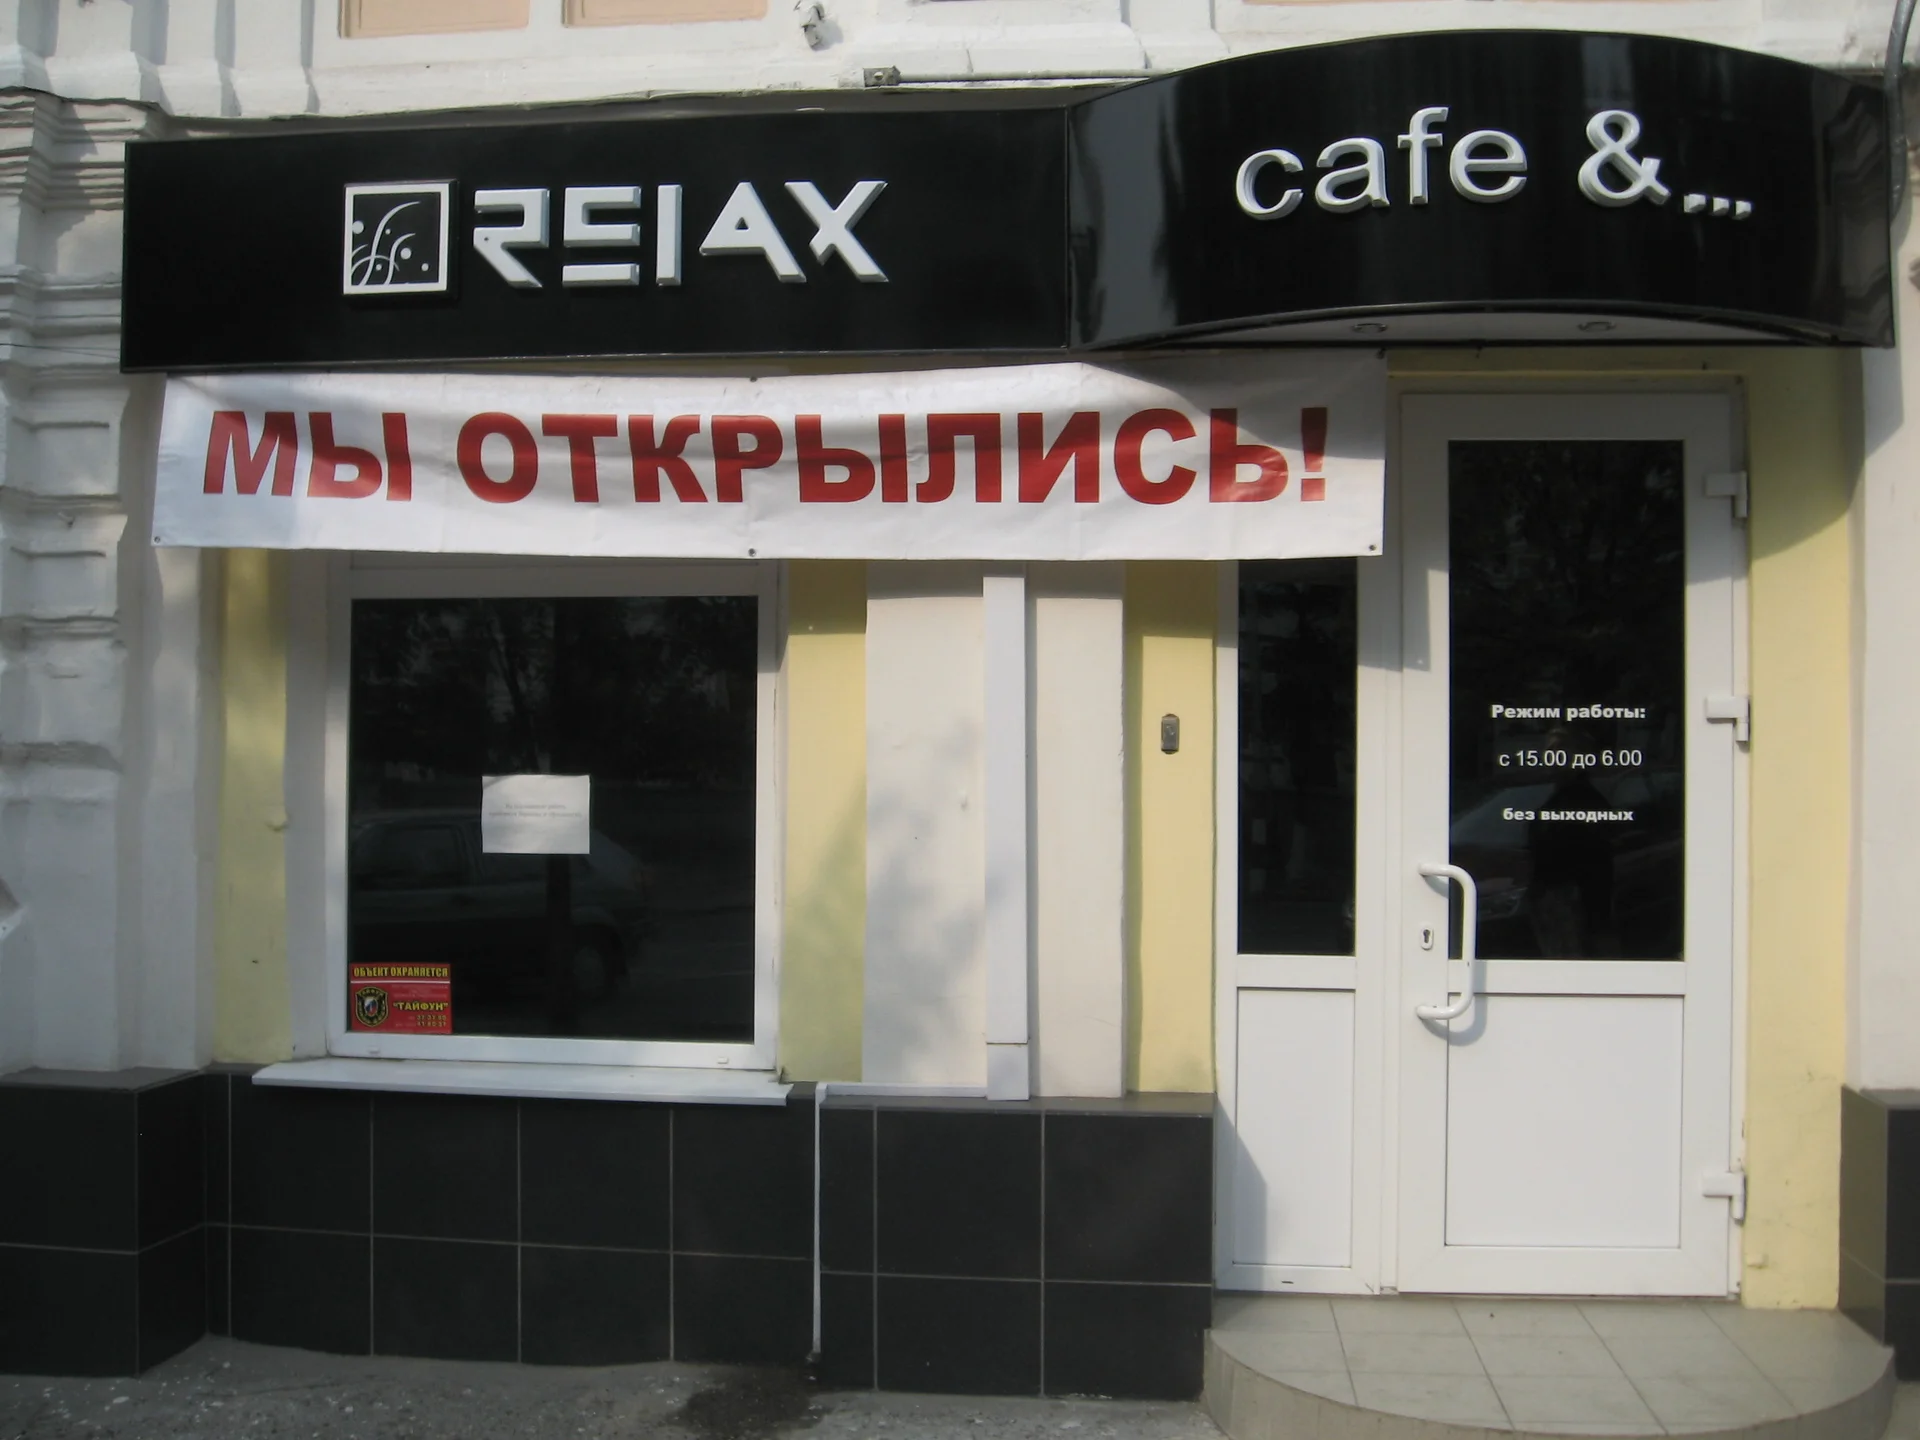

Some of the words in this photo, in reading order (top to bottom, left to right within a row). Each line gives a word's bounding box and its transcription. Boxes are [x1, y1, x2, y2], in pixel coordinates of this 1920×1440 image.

[1236, 107, 1527, 214] cafe
[203, 411, 412, 501] МЫ
[457, 407, 1327, 505] ОТКРЫЛИСЬ!
[1492, 705, 1560, 718] Режим
[1567, 704, 1645, 721] работы:
[1499, 754, 1510, 767] с
[1517, 750, 1566, 766] 15.00
[1572, 754, 1596, 768] до
[1603, 750, 1641, 765] 6.00
[1503, 808, 1535, 820] без
[1541, 811, 1633, 822] выходных
[353, 967, 389, 977] ОБЪЕКТ
[390, 967, 448, 977] ОХРАНЯЕТСЯ
